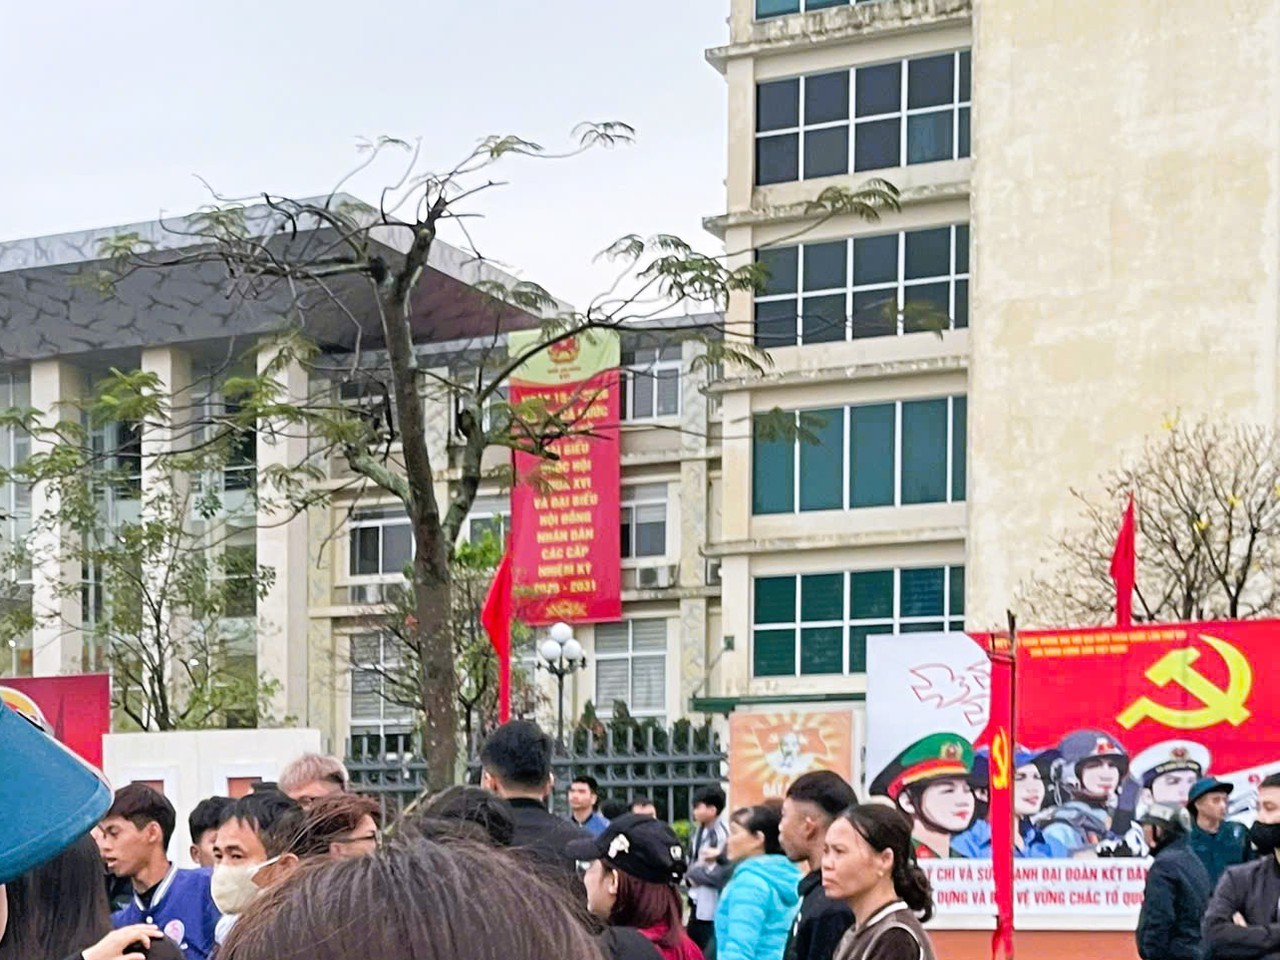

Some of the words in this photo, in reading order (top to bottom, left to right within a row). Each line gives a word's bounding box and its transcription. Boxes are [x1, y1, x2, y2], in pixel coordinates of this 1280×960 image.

[936, 865, 955, 881] CHÍ
[959, 863, 973, 881] VÀ
[977, 864, 994, 881] SỨ
[1013, 866, 1038, 884] ẠNH
[1042, 865, 1061, 884] ĐẠI
[1065, 862, 1098, 881] ĐOÀN
[1102, 863, 1123, 881] KẾT
[937, 889, 967, 907] DỰNG
[972, 887, 986, 904] VÀ
[1034, 887, 1065, 905] VỮNG
[1069, 886, 1101, 905] CHẮC
